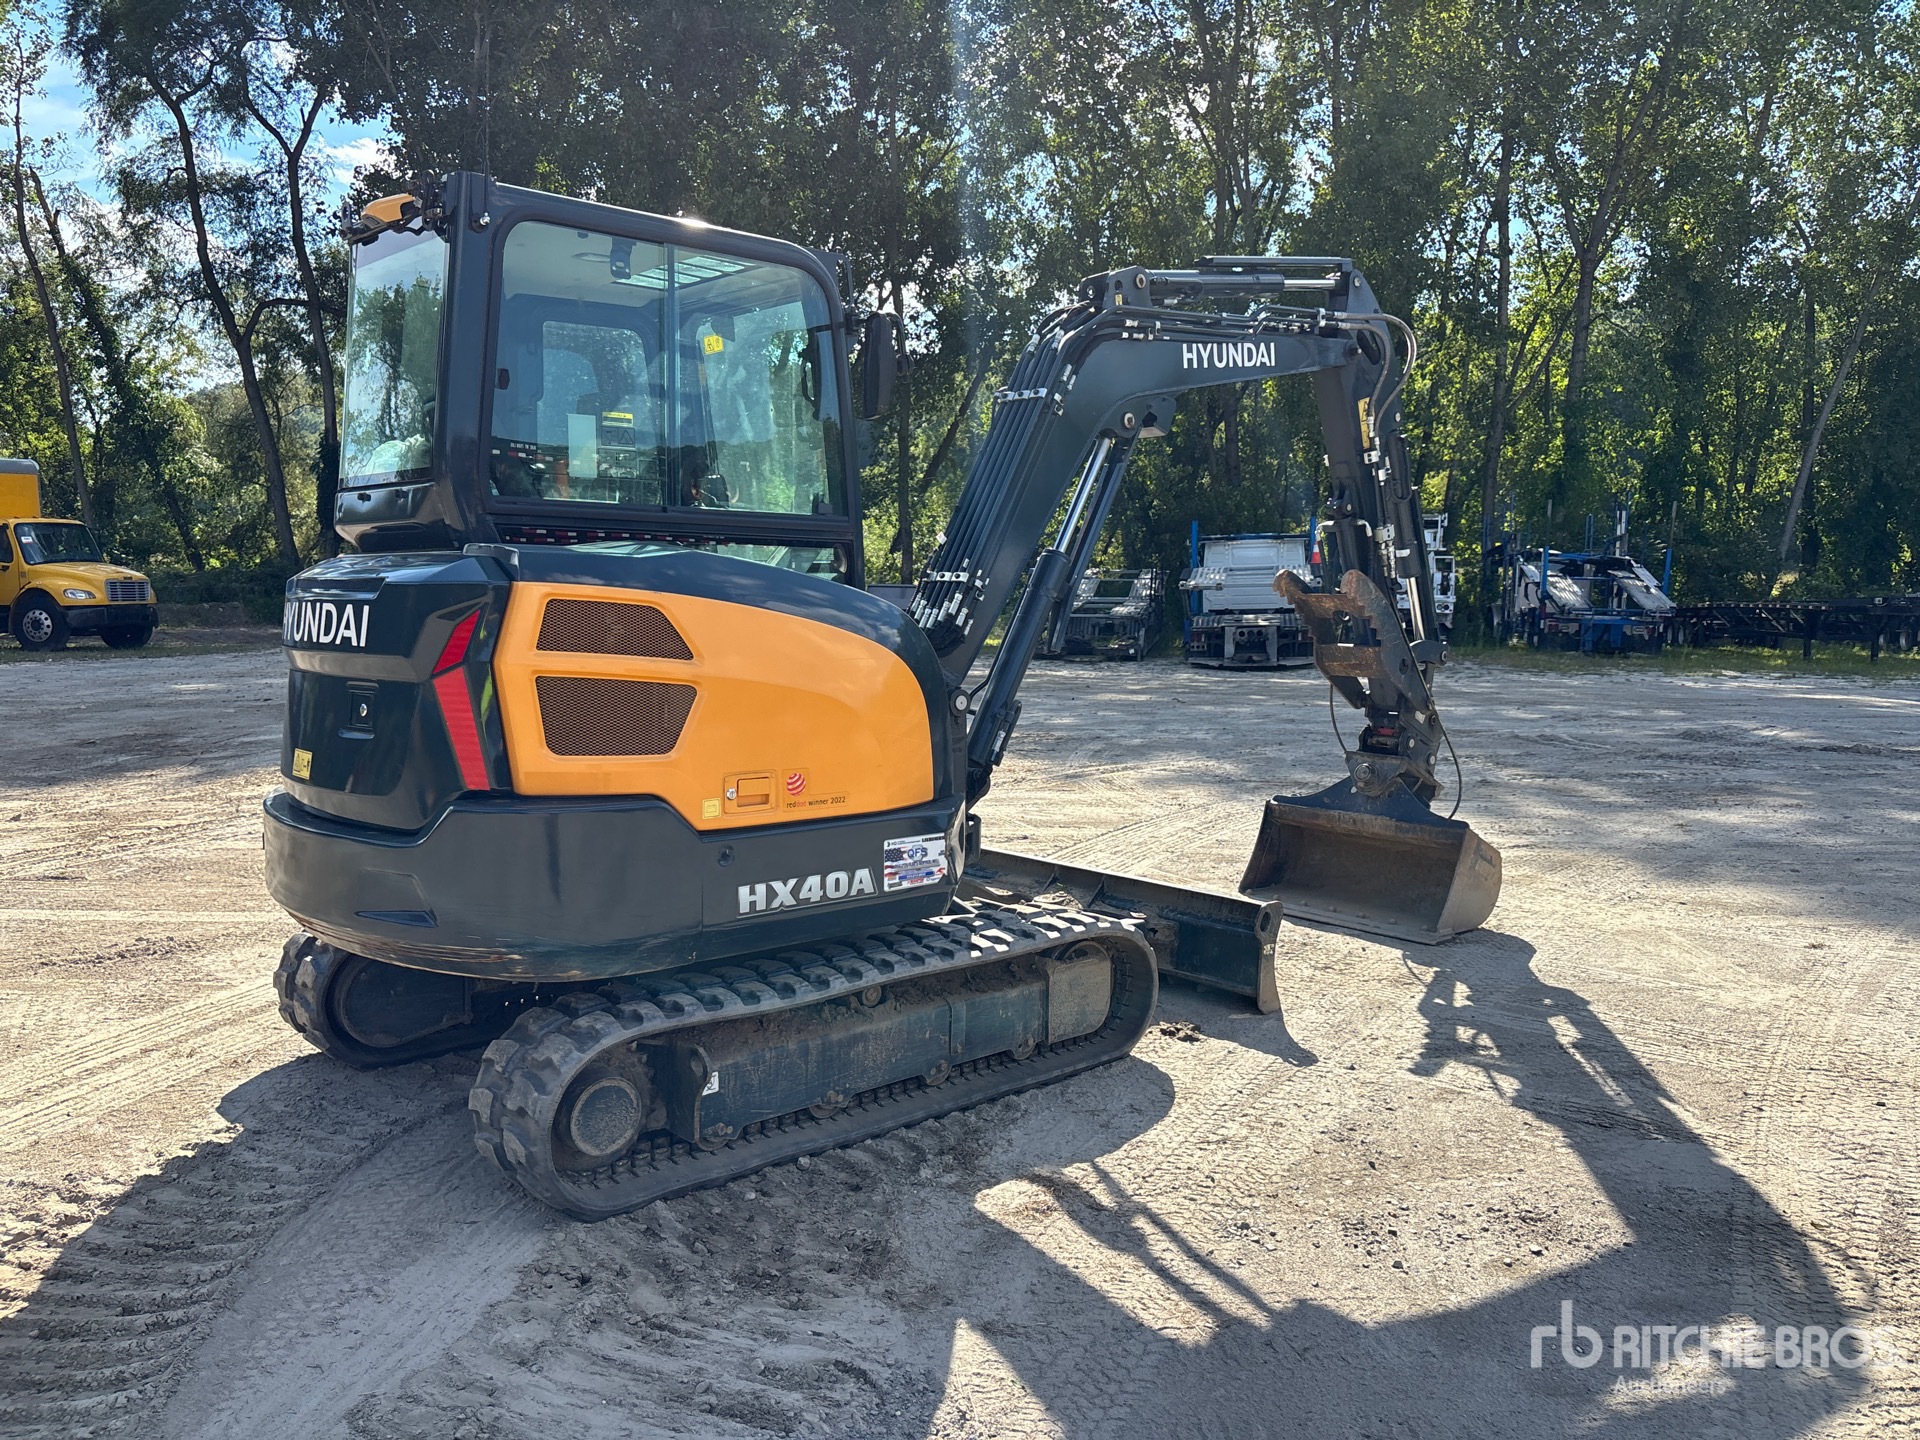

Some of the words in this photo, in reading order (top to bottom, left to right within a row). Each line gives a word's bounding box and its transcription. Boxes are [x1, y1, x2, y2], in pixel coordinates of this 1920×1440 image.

[1182, 342, 1276, 369] HYUNDAI
[283, 601, 370, 648] HYUNDAI
[830, 796, 846, 805] 2022
[907, 846, 928, 861] QFS
[738, 868, 875, 914] HX40A
